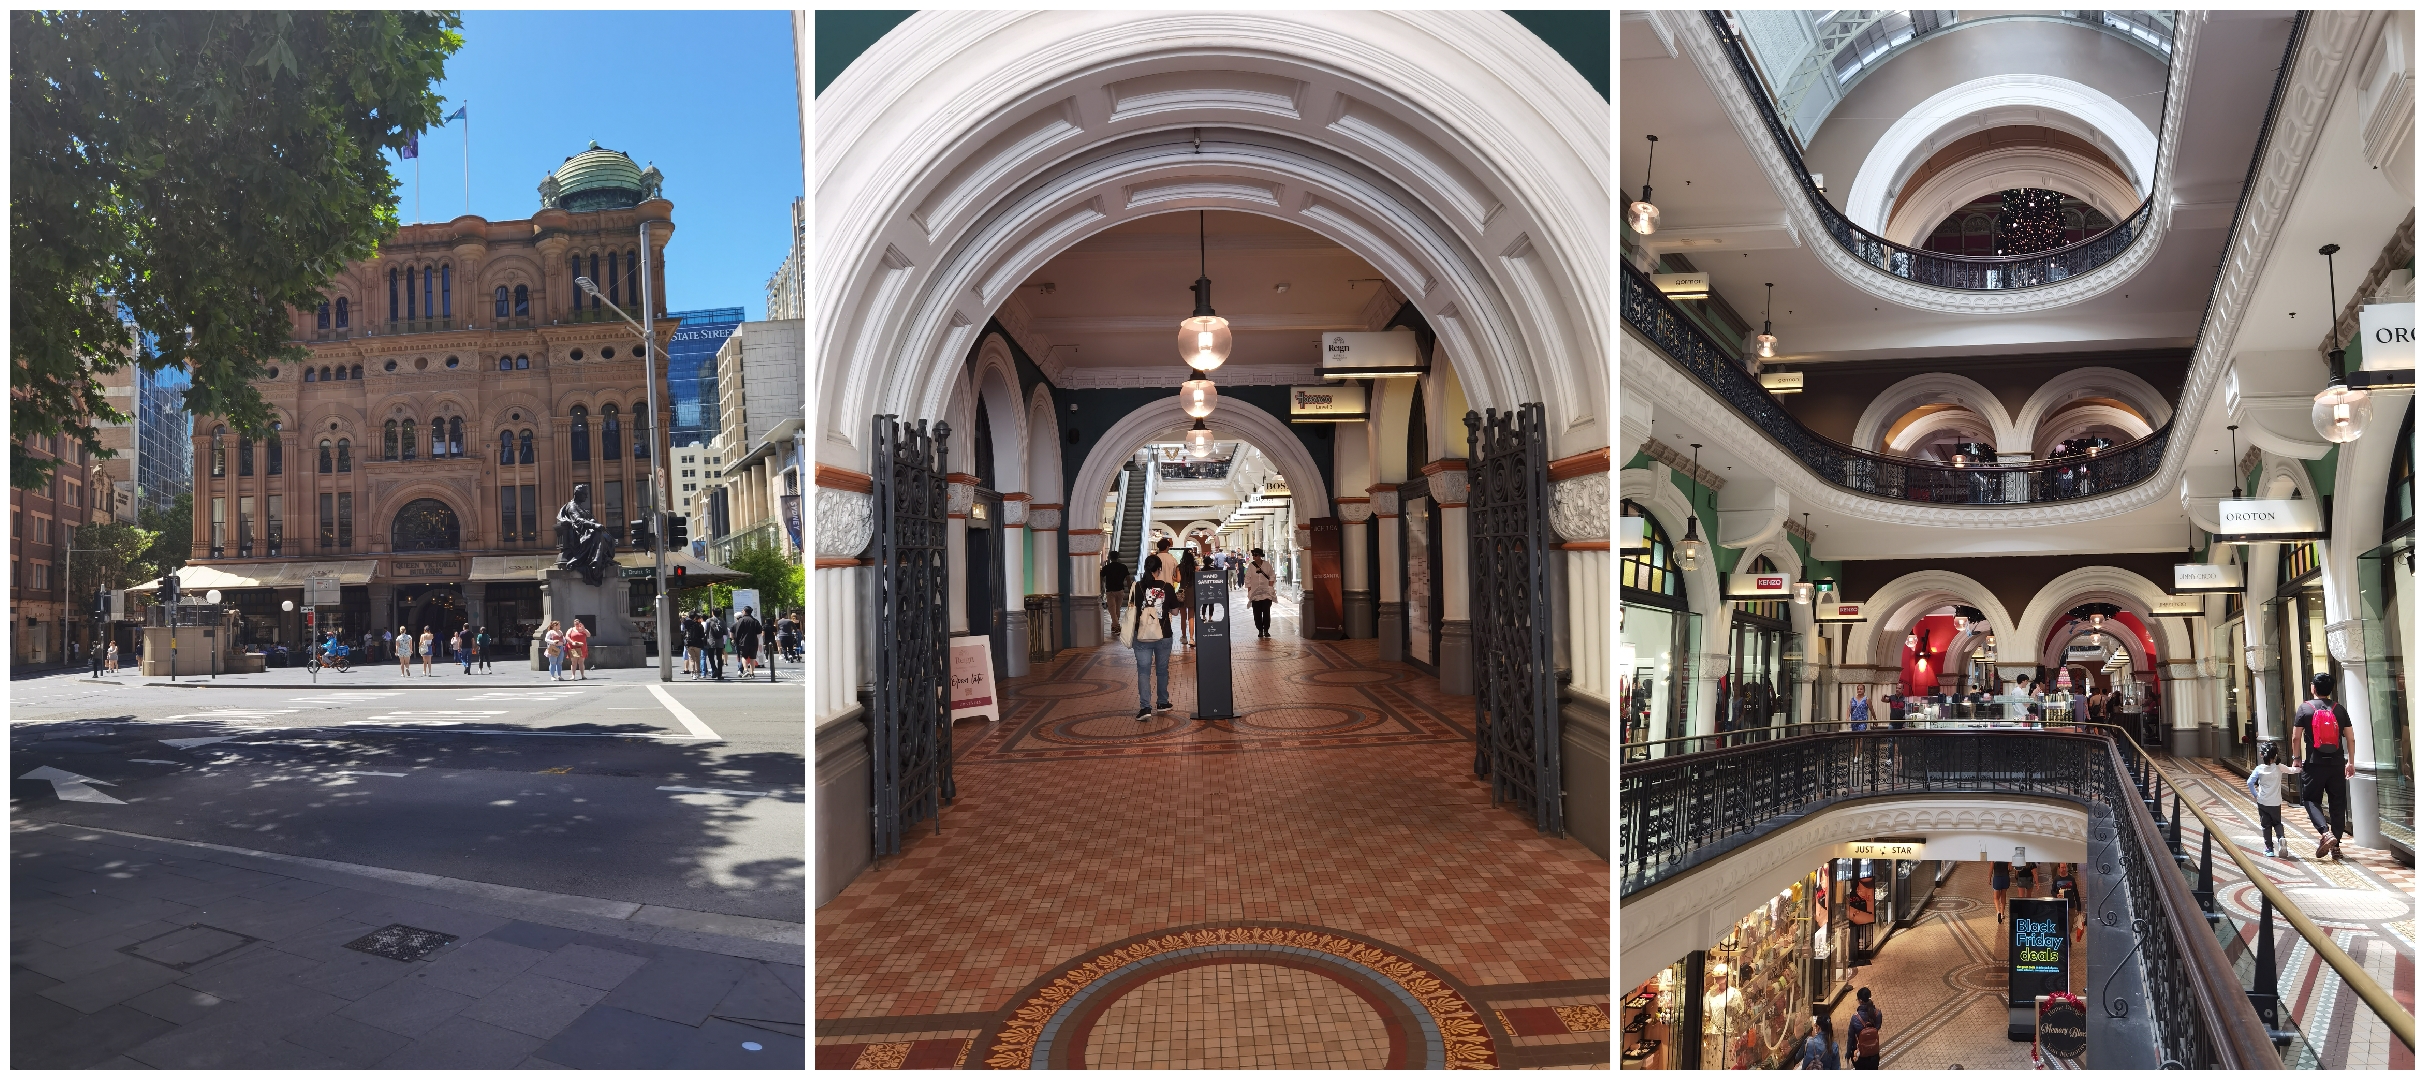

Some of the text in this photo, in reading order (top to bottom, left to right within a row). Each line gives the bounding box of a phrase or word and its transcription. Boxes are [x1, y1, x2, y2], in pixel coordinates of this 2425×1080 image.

[671, 331, 700, 342] STATE
[2375, 327, 2416, 344] OR
[1328, 345, 1350, 353] Reign
[790, 501, 800, 530] SYDNEY
[2226, 512, 2275, 521] OROTON
[1854, 846, 1912, 854] JUST STAR
[2016, 918, 2057, 933] Black
[2016, 932, 2064, 950] Friday
[2020, 946, 2059, 962] deals
[2040, 1022, 2069, 1036] Memory
